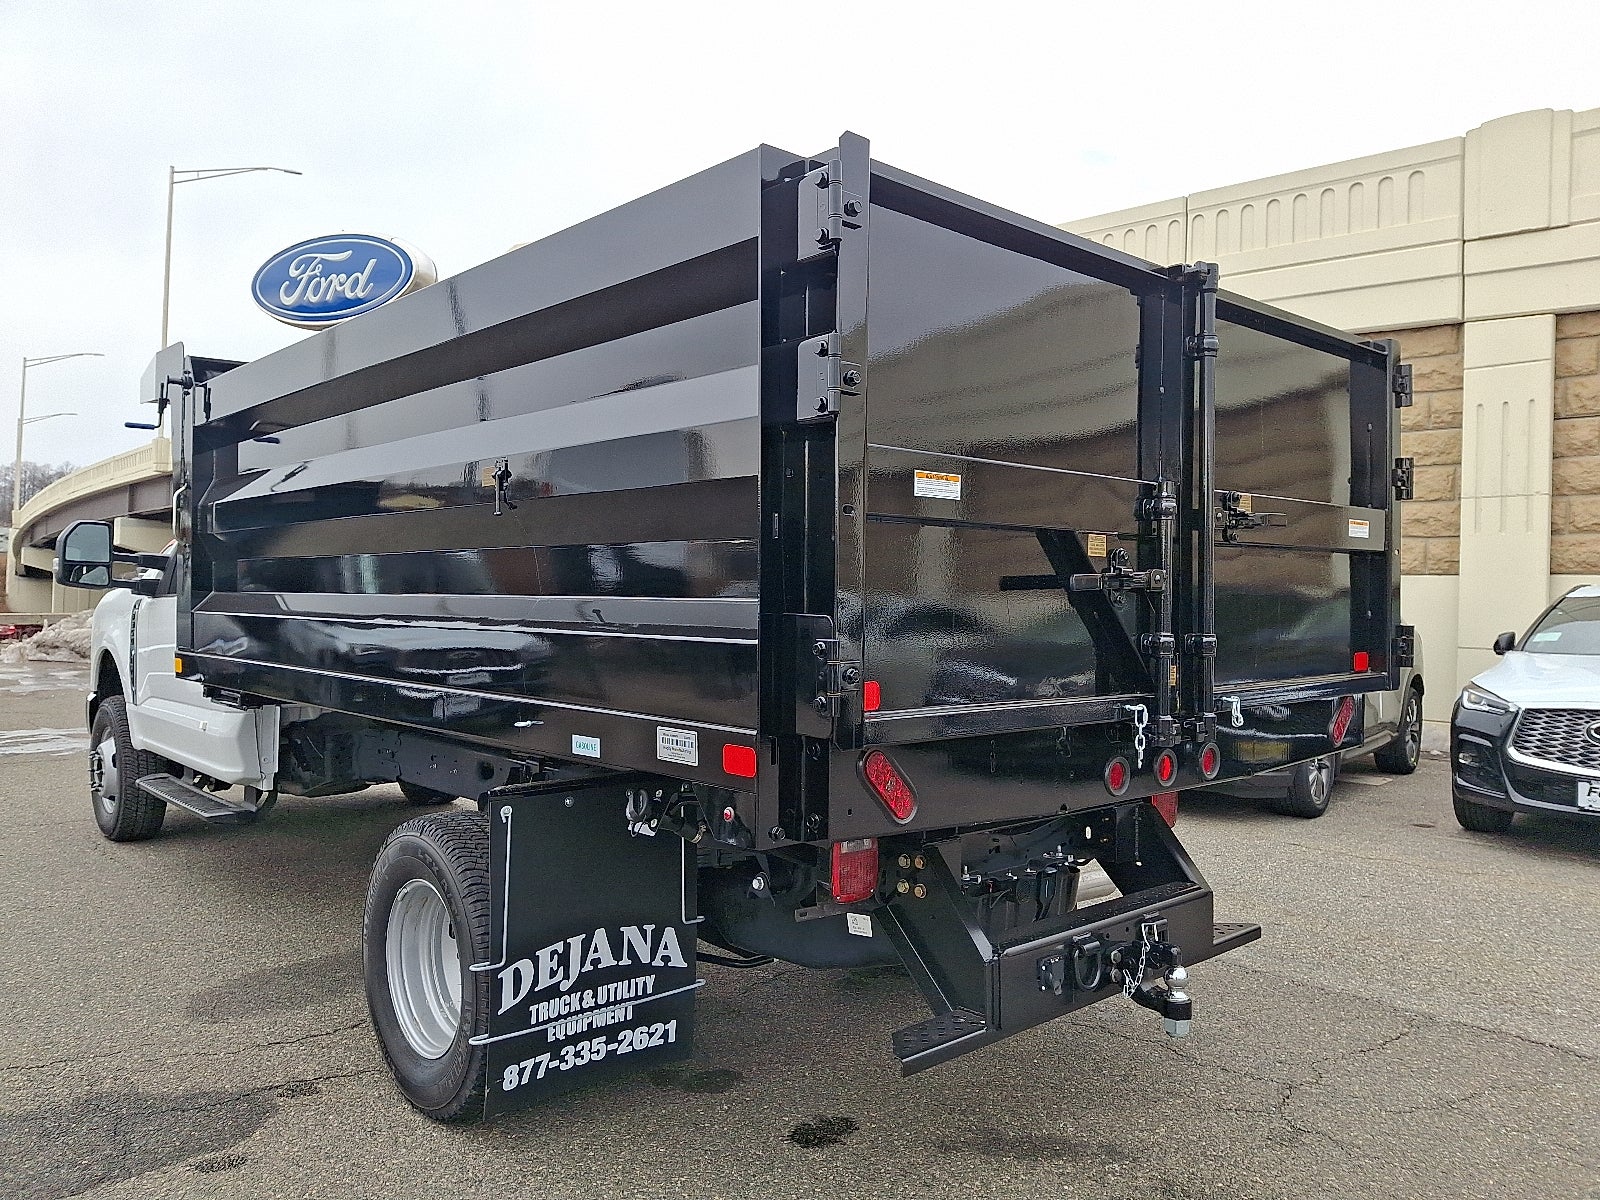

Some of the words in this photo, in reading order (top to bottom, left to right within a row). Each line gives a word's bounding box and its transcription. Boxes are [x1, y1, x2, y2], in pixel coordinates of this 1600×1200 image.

[279, 250, 377, 306] Ford
[1587, 786, 1600, 798] F
[498, 924, 687, 1015] DEJANA
[529, 991, 582, 1025] TRUCK
[597, 974, 656, 1005] UTILITY
[547, 1004, 633, 1042] EQUIPMENT
[502, 1019, 677, 1091] 877-335-2621
